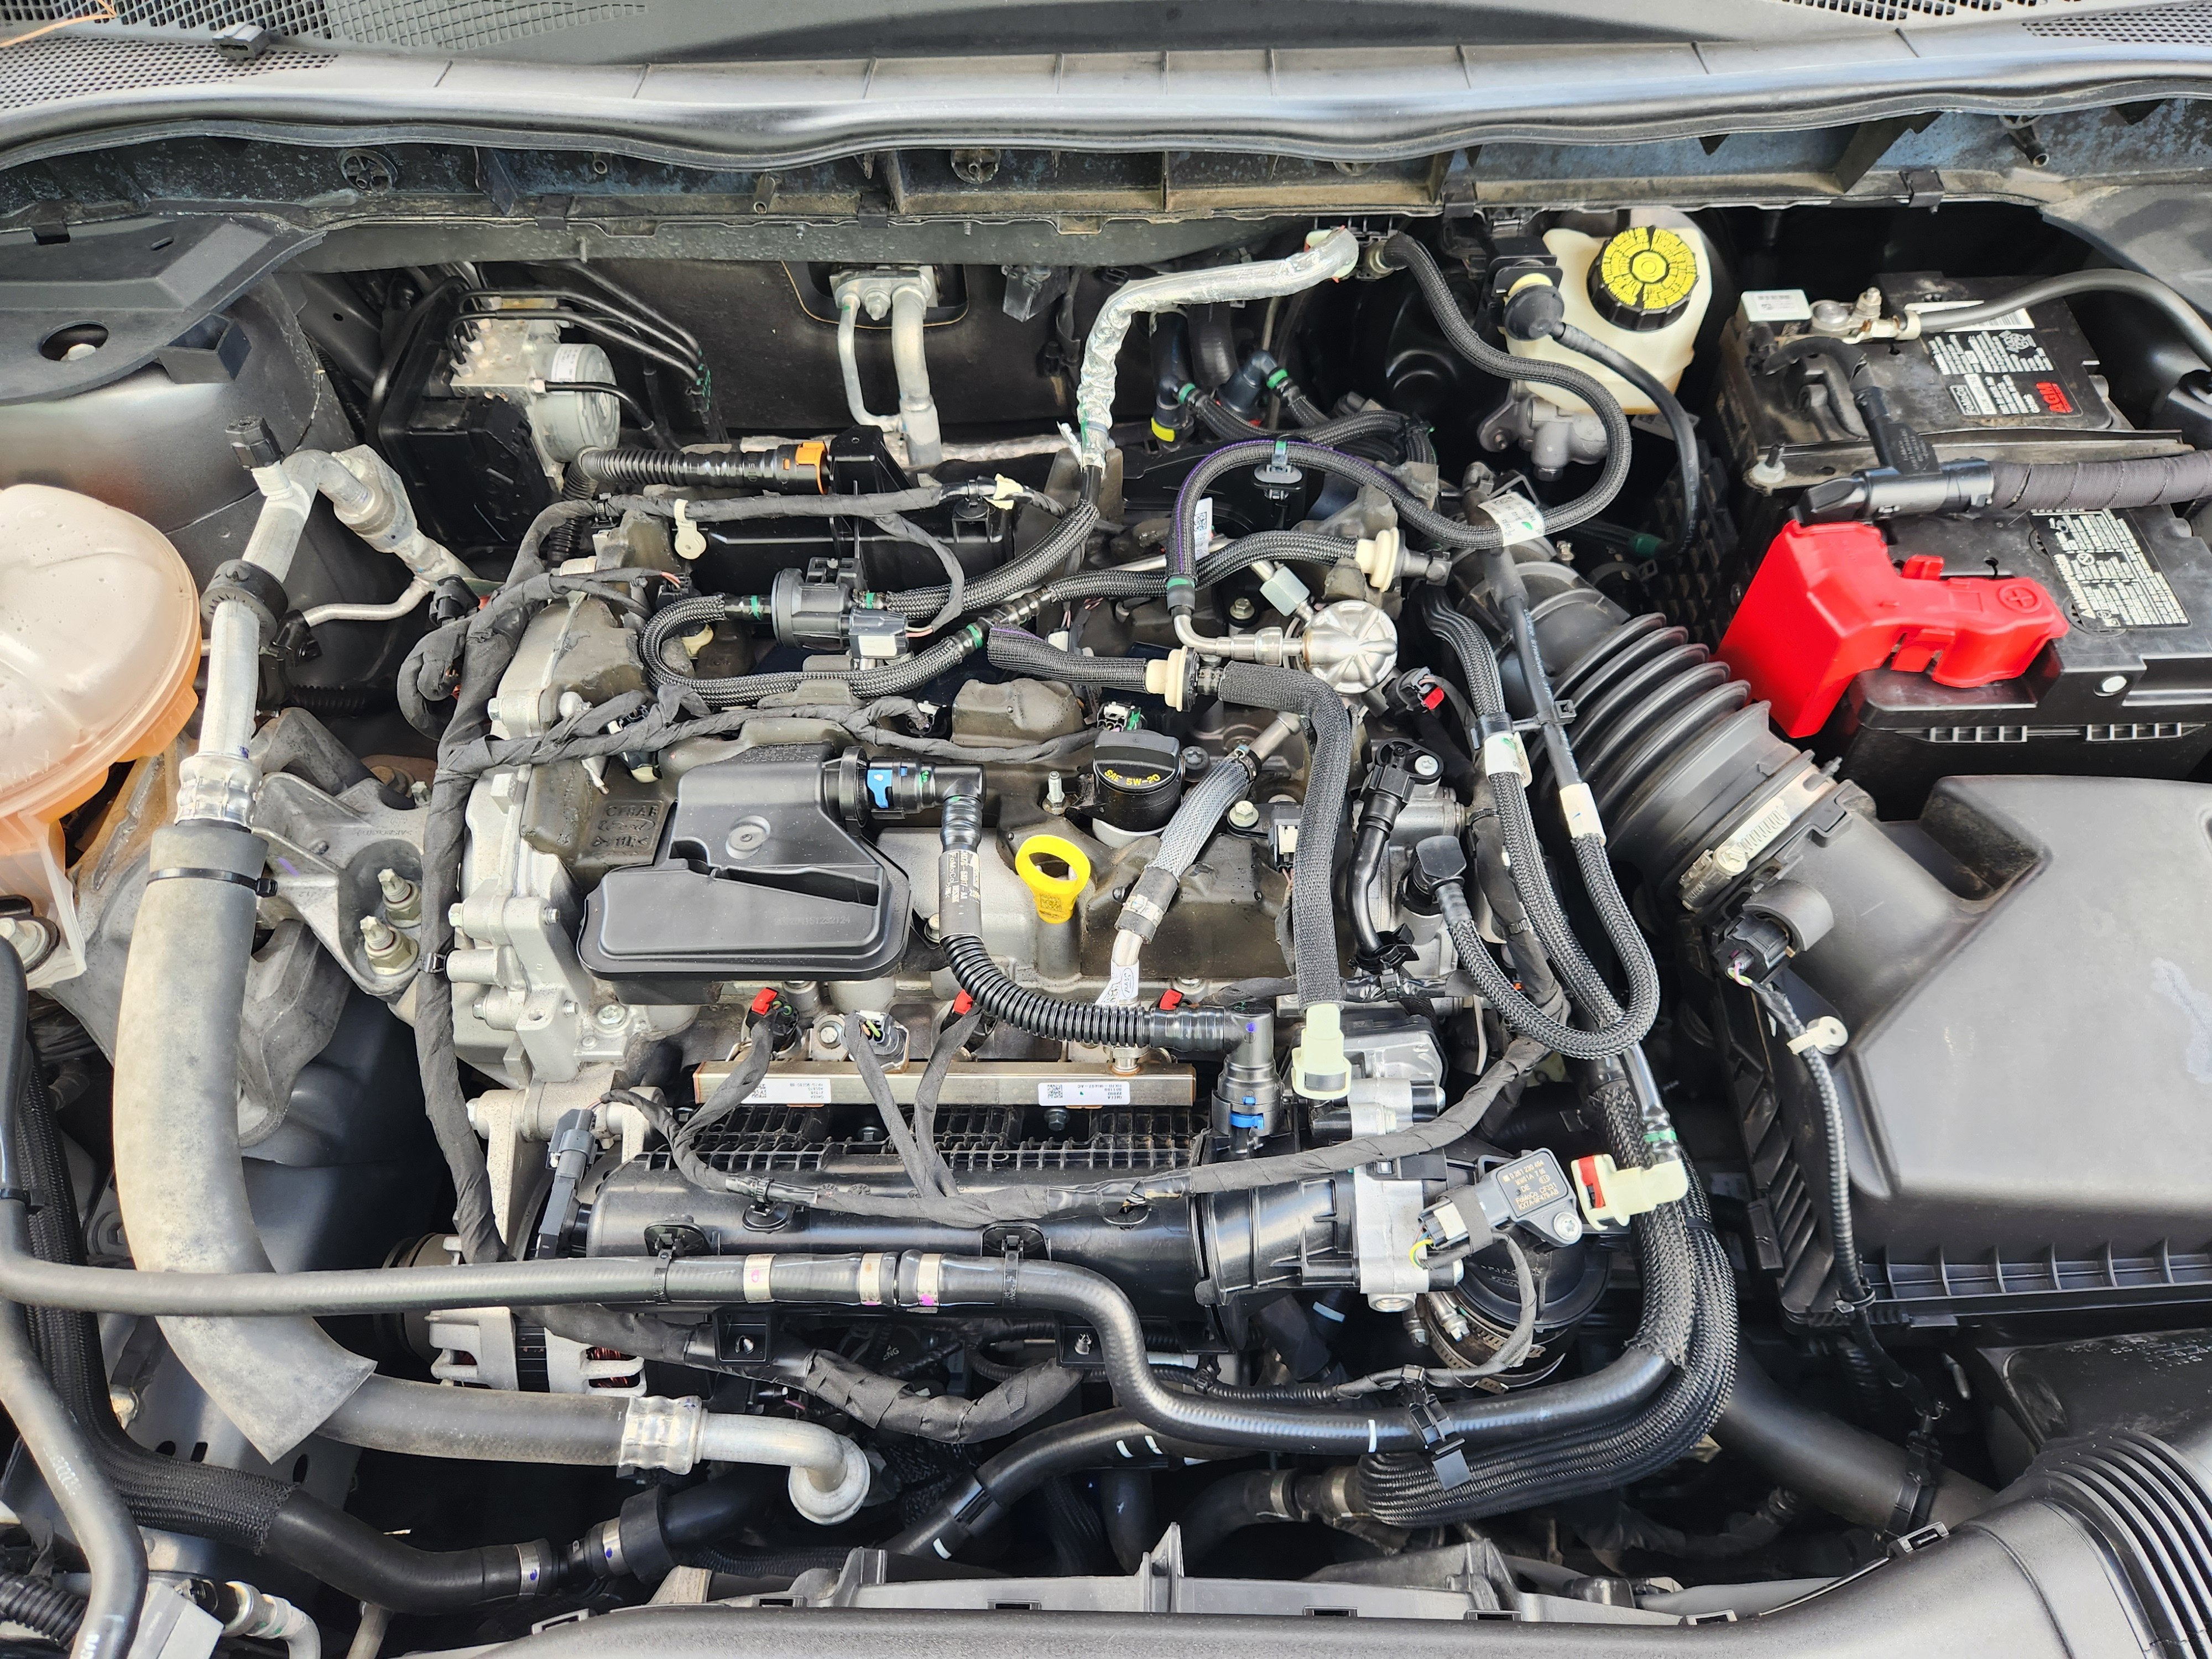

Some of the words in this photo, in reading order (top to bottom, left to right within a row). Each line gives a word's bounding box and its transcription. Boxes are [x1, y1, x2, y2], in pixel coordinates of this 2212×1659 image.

[2036, 382, 2064, 413] AGM
[1104, 769, 1123, 784] SAE
[1126, 774, 1161, 786] 5W-20
[1520, 1183, 1531, 1192] DE
[1515, 1191, 1538, 1204] FoMoCo
